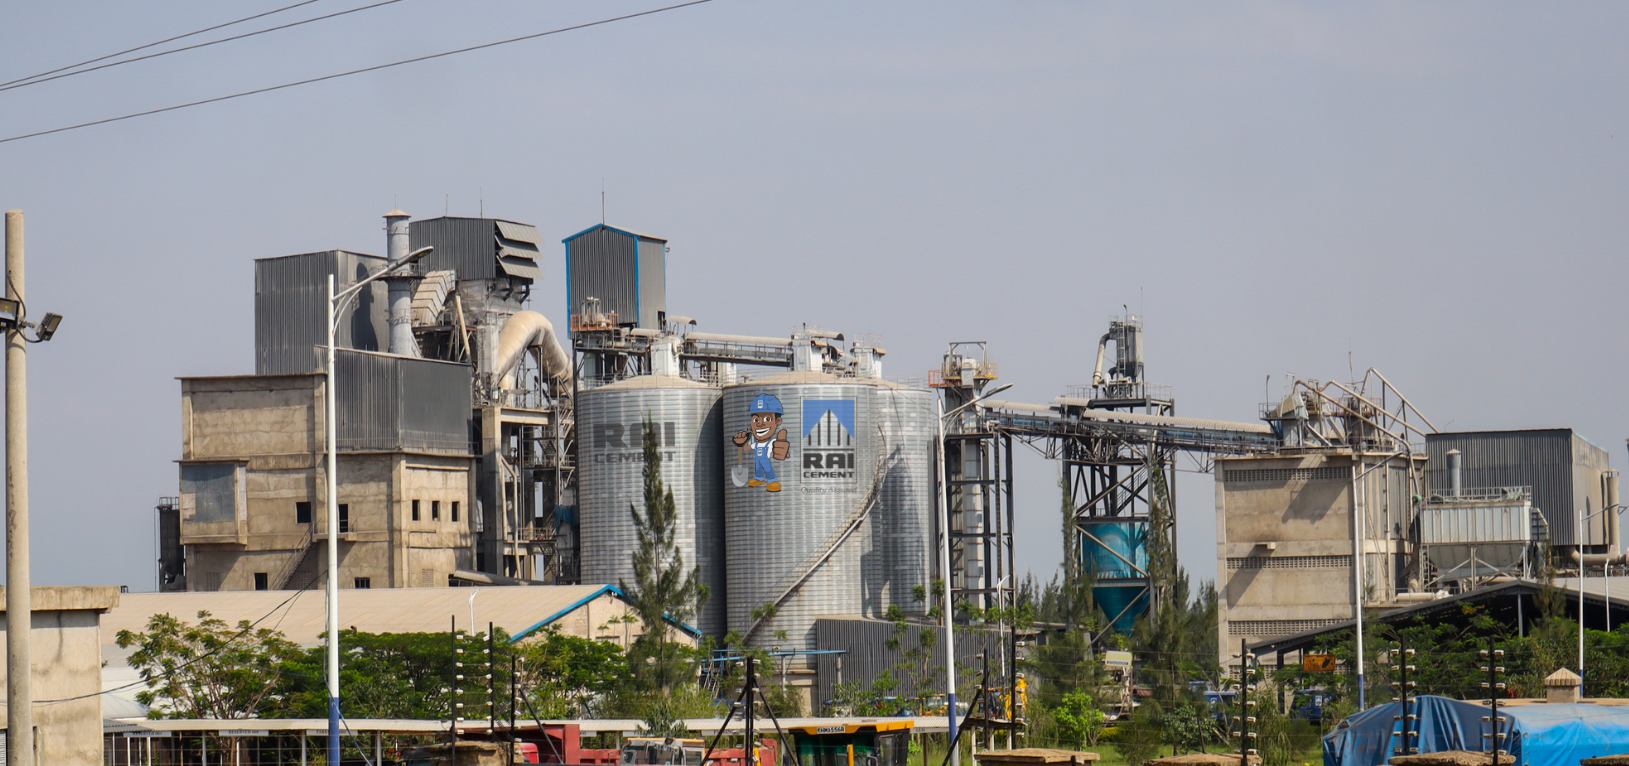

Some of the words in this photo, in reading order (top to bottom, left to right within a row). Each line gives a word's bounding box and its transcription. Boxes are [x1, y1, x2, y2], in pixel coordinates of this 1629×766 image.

[593, 422, 675, 448] RAI
[803, 453, 854, 469] RAI
[803, 471, 855, 479] CEMENT
[800, 486, 827, 495] Quality
